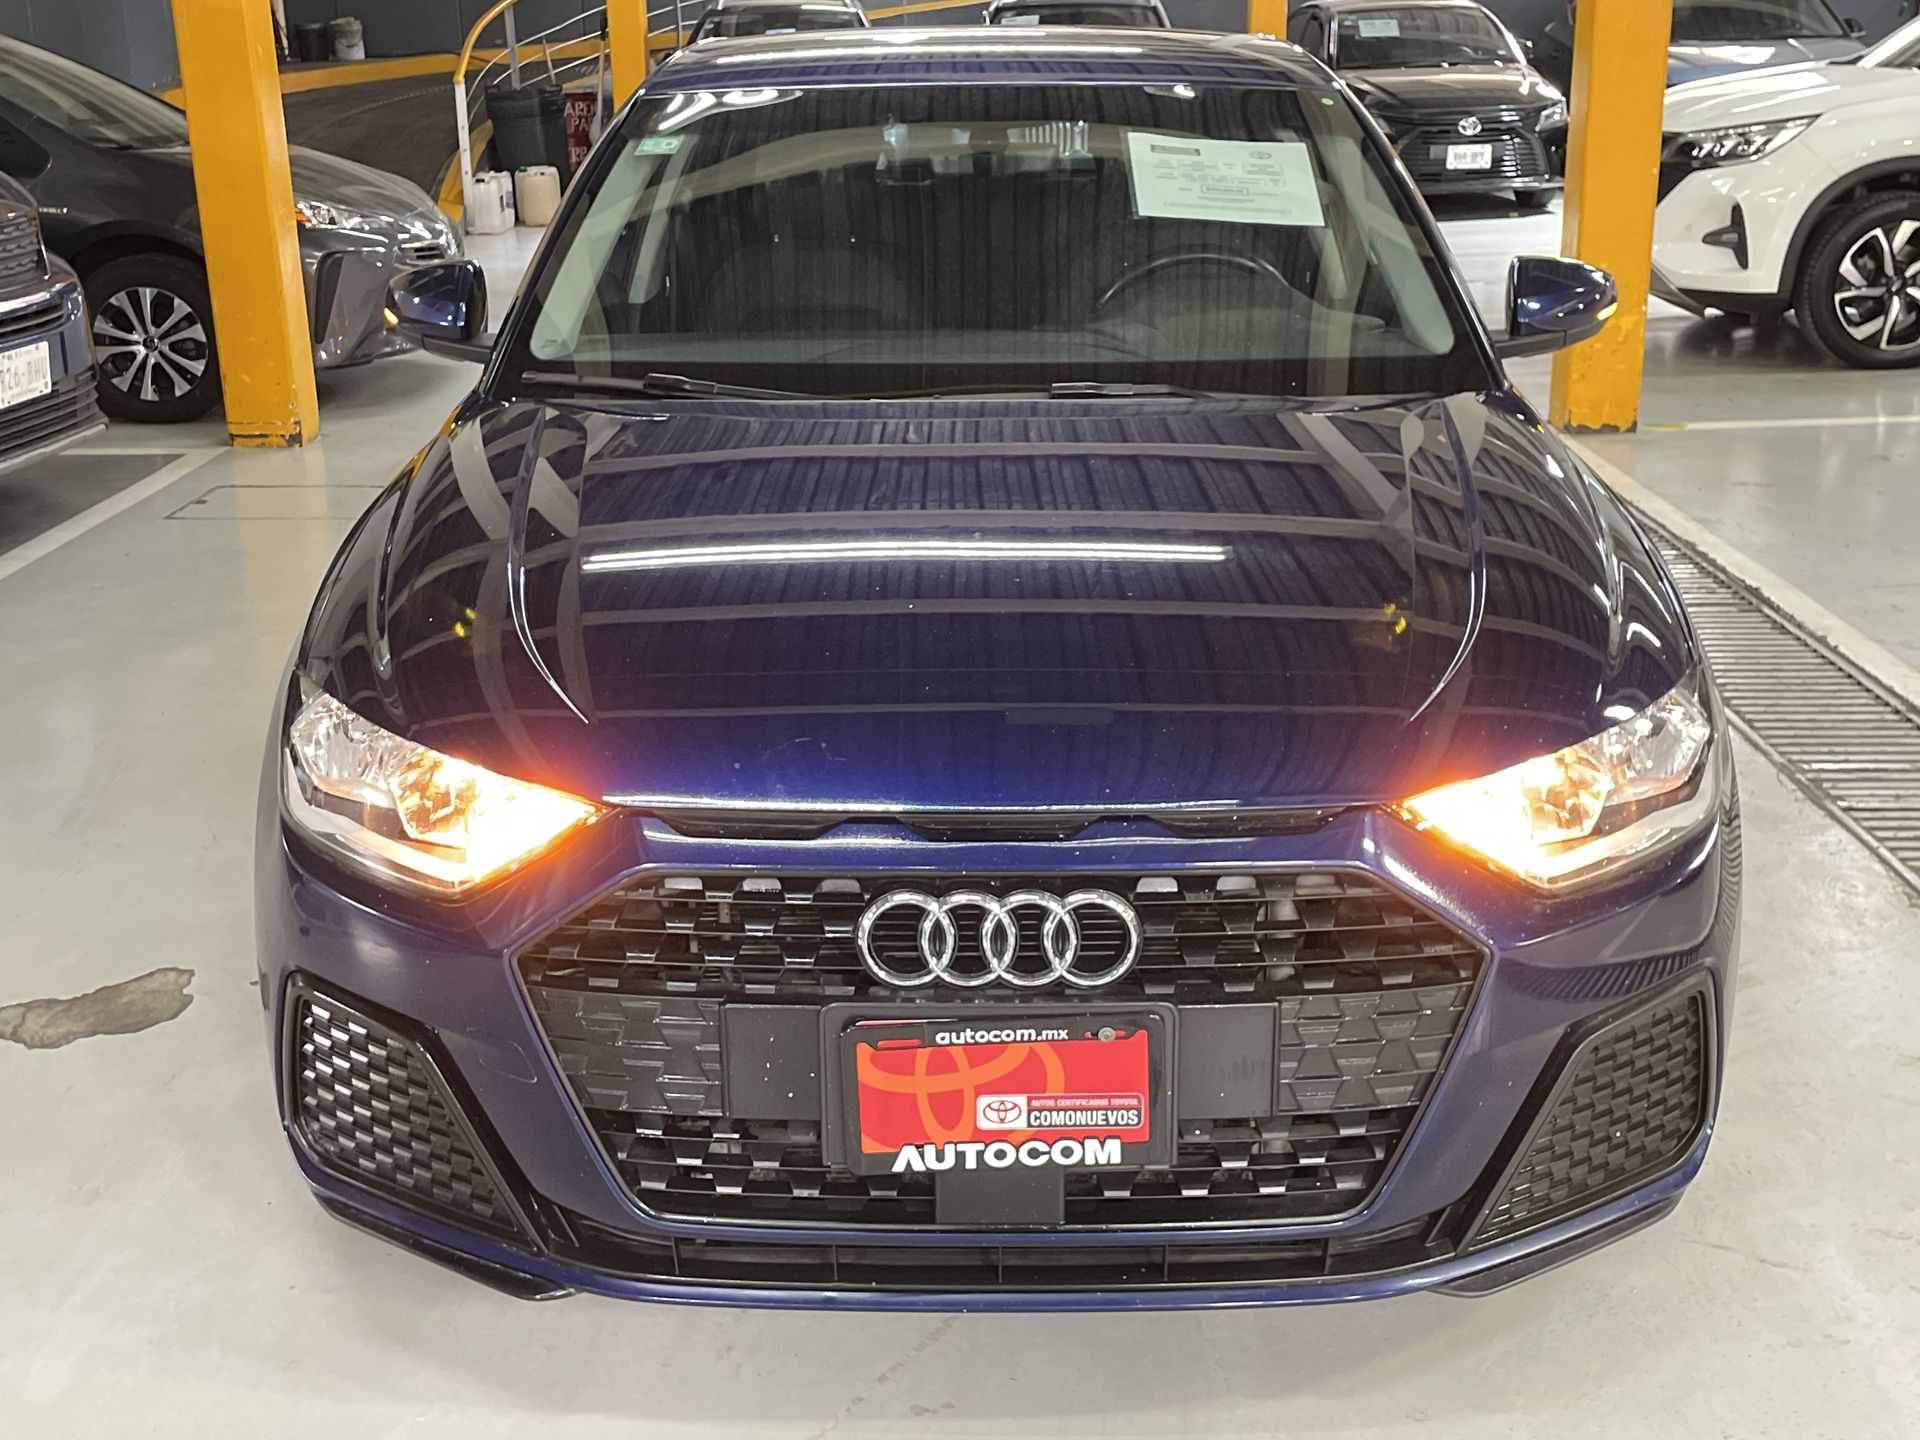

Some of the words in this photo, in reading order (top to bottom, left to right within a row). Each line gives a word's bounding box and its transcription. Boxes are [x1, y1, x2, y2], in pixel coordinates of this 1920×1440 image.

[935, 1027, 1069, 1045] autocom.mx
[1031, 1099, 1056, 1107] AUTOS
[1057, 1098, 1109, 1107] CERTIFICADOS
[1111, 1098, 1139, 1106] TOYOTA
[1030, 1109, 1139, 1126] COMONUEVOS
[891, 1138, 1122, 1173] AUTOCOM
